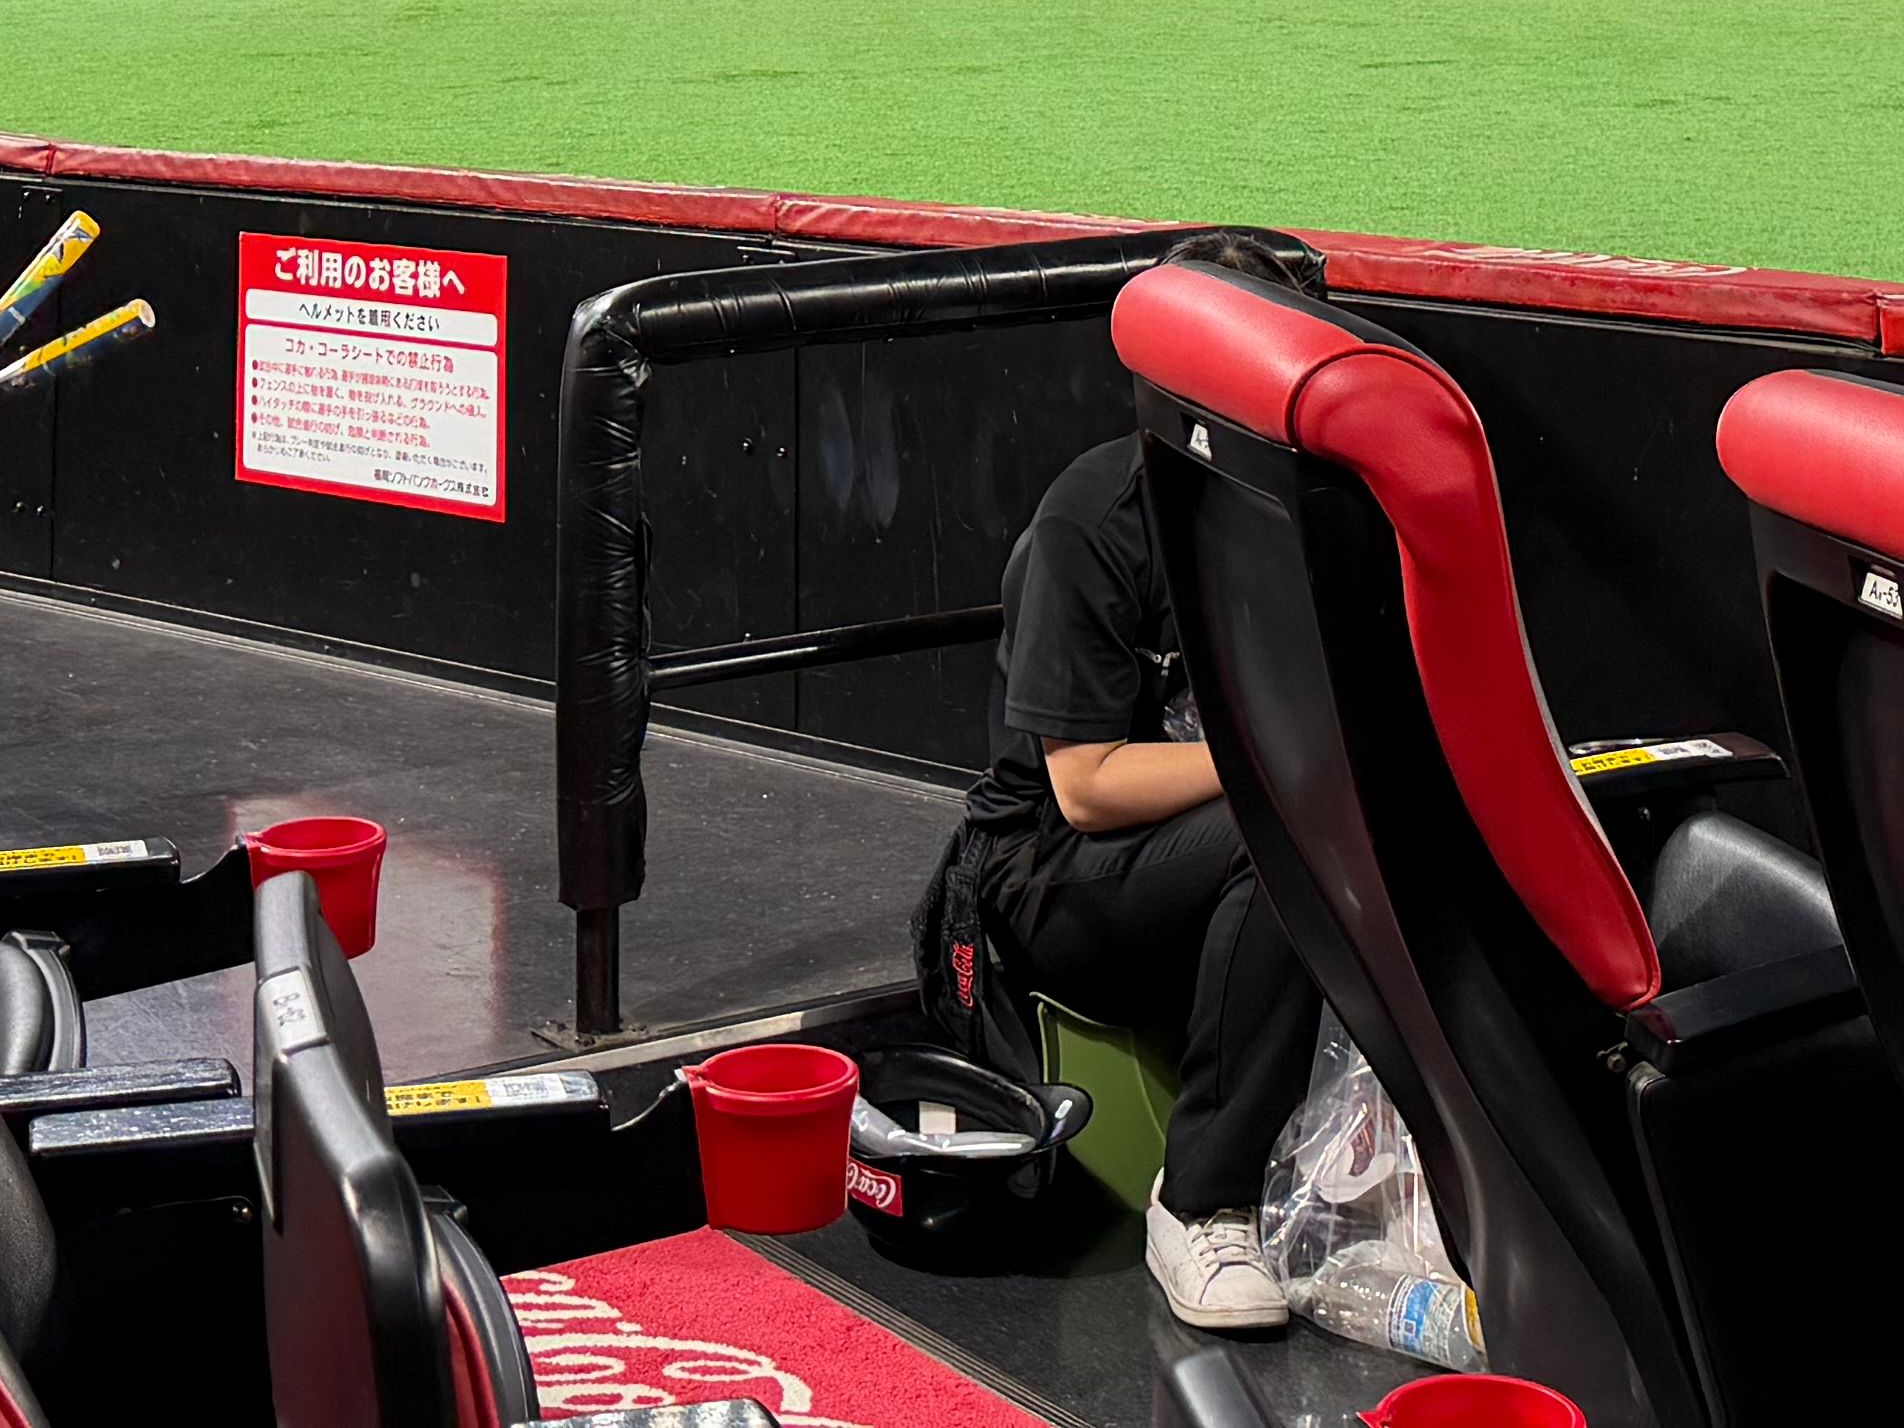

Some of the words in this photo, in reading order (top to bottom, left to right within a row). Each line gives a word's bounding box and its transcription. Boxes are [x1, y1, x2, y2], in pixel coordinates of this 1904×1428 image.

[274, 246, 466, 299] ご利用のお客様へ
